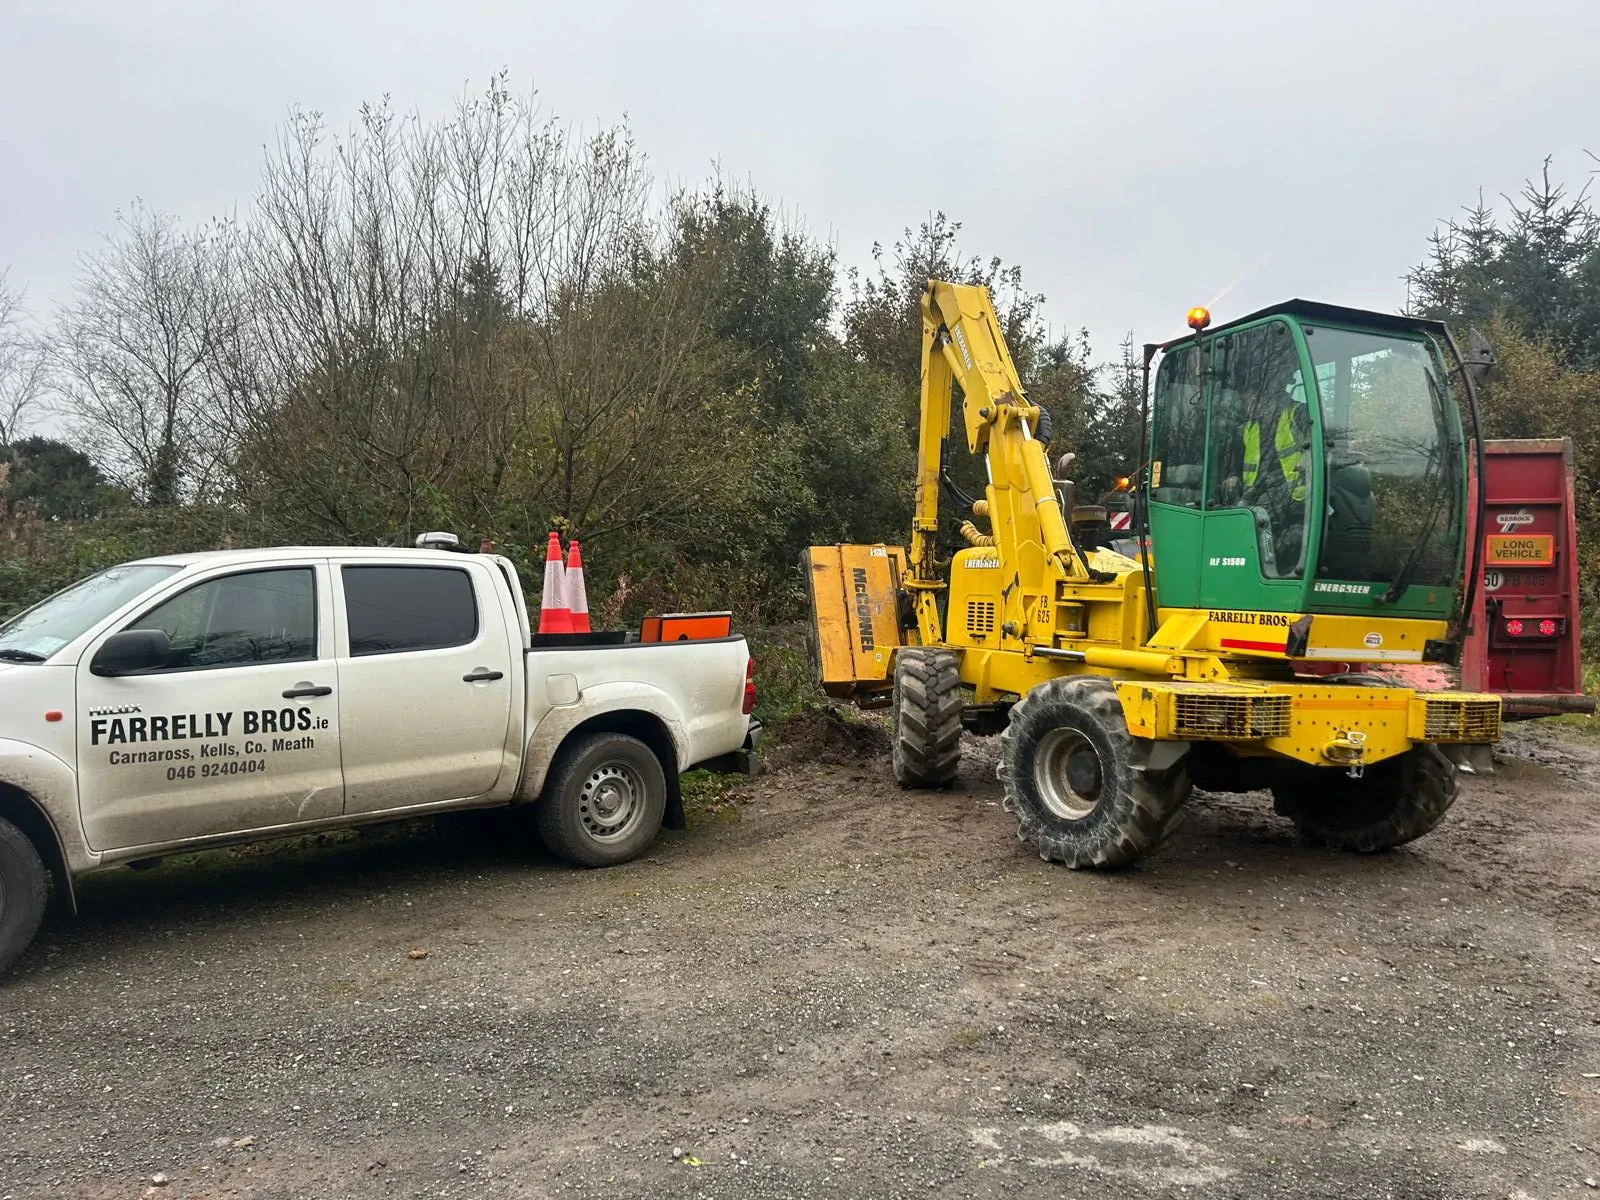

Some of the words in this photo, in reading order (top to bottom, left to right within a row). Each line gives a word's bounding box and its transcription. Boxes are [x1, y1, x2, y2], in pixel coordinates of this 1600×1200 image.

[1503, 540, 1533, 548] LONG
[1496, 549, 1541, 557] VEHICLE
[1209, 557, 1221, 566] ILF
[1040, 595, 1049, 609] FB
[1037, 609, 1050, 624] 625
[1208, 610, 1257, 625] FARRELLY
[91, 712, 234, 745] FARRELLY
[243, 706, 329, 734] BROS.ie
[109, 747, 195, 766] Carnaross,
[200, 743, 240, 759] Kells,
[244, 740, 267, 754] Co.
[272, 736, 315, 752] Meath
[166, 767, 196, 781] 046
[201, 759, 266, 777] 9240404
